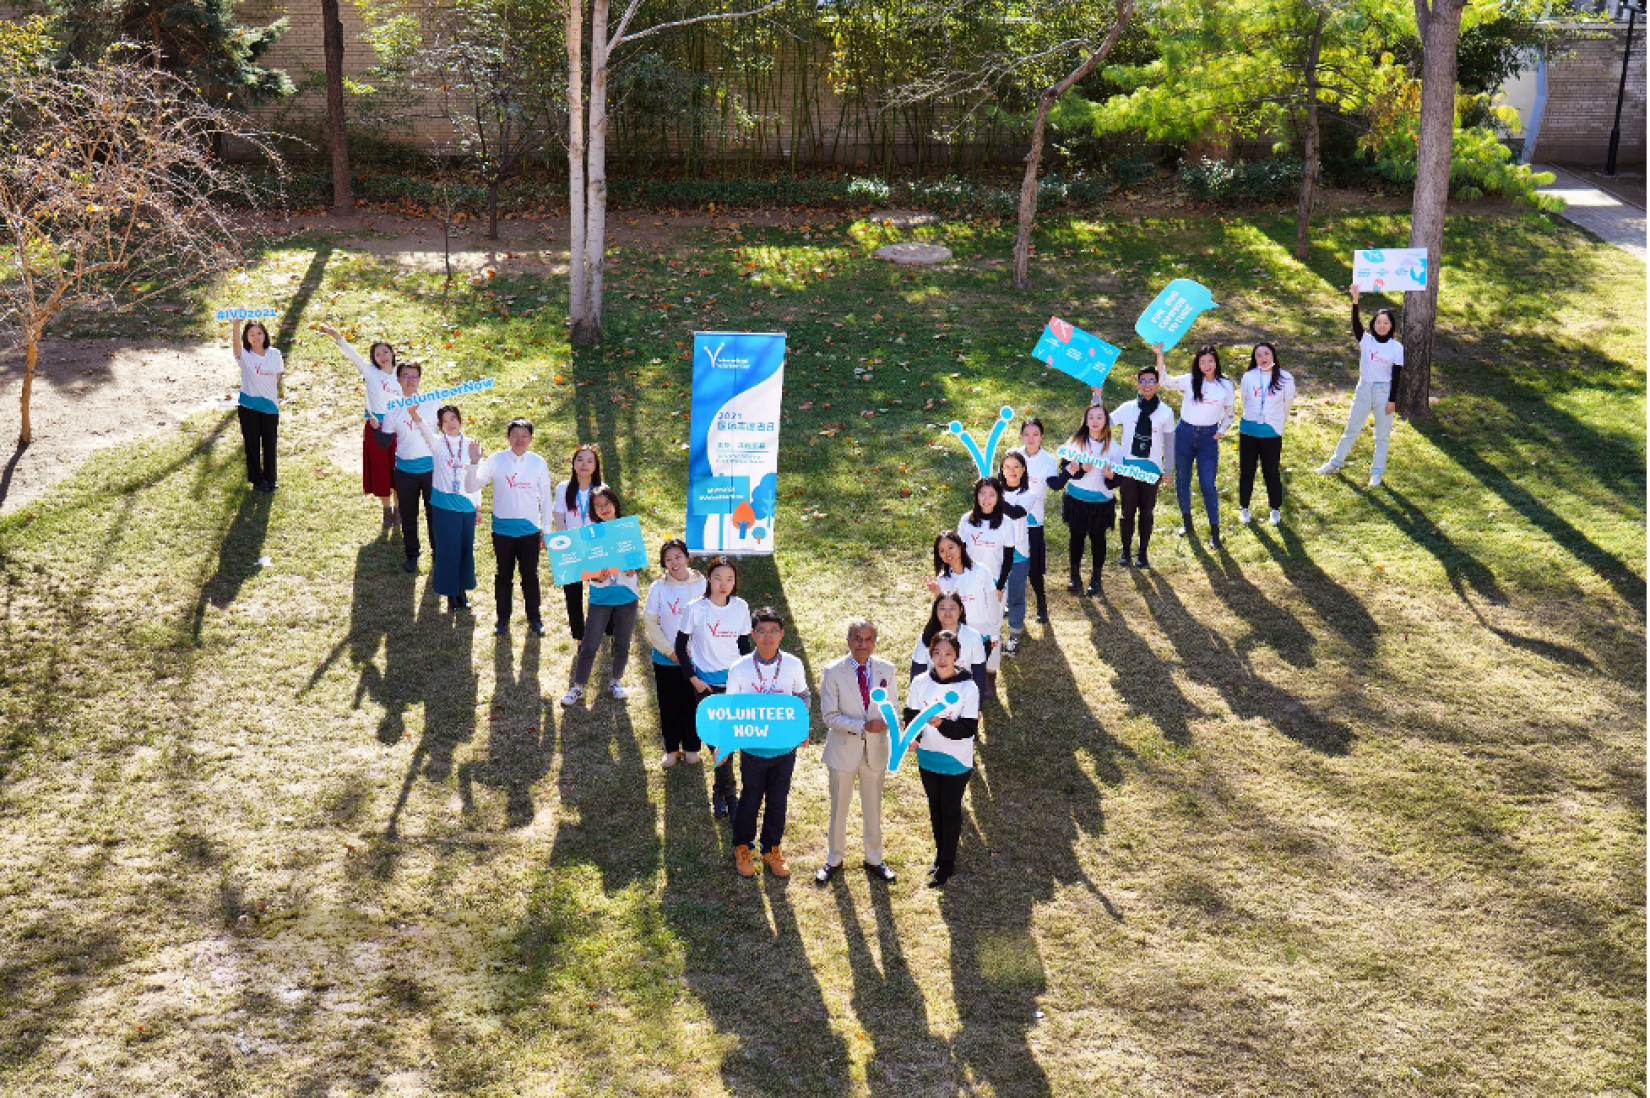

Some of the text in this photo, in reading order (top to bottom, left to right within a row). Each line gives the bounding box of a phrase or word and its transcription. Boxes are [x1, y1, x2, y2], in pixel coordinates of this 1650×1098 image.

[217, 309, 276, 319] #IVD2021
[387, 379, 494, 410] #VolunteerNow
[1058, 448, 1157, 482] #VoluneerNow
[707, 707, 795, 721] VOLUNTEER
[733, 724, 769, 738] NOW
